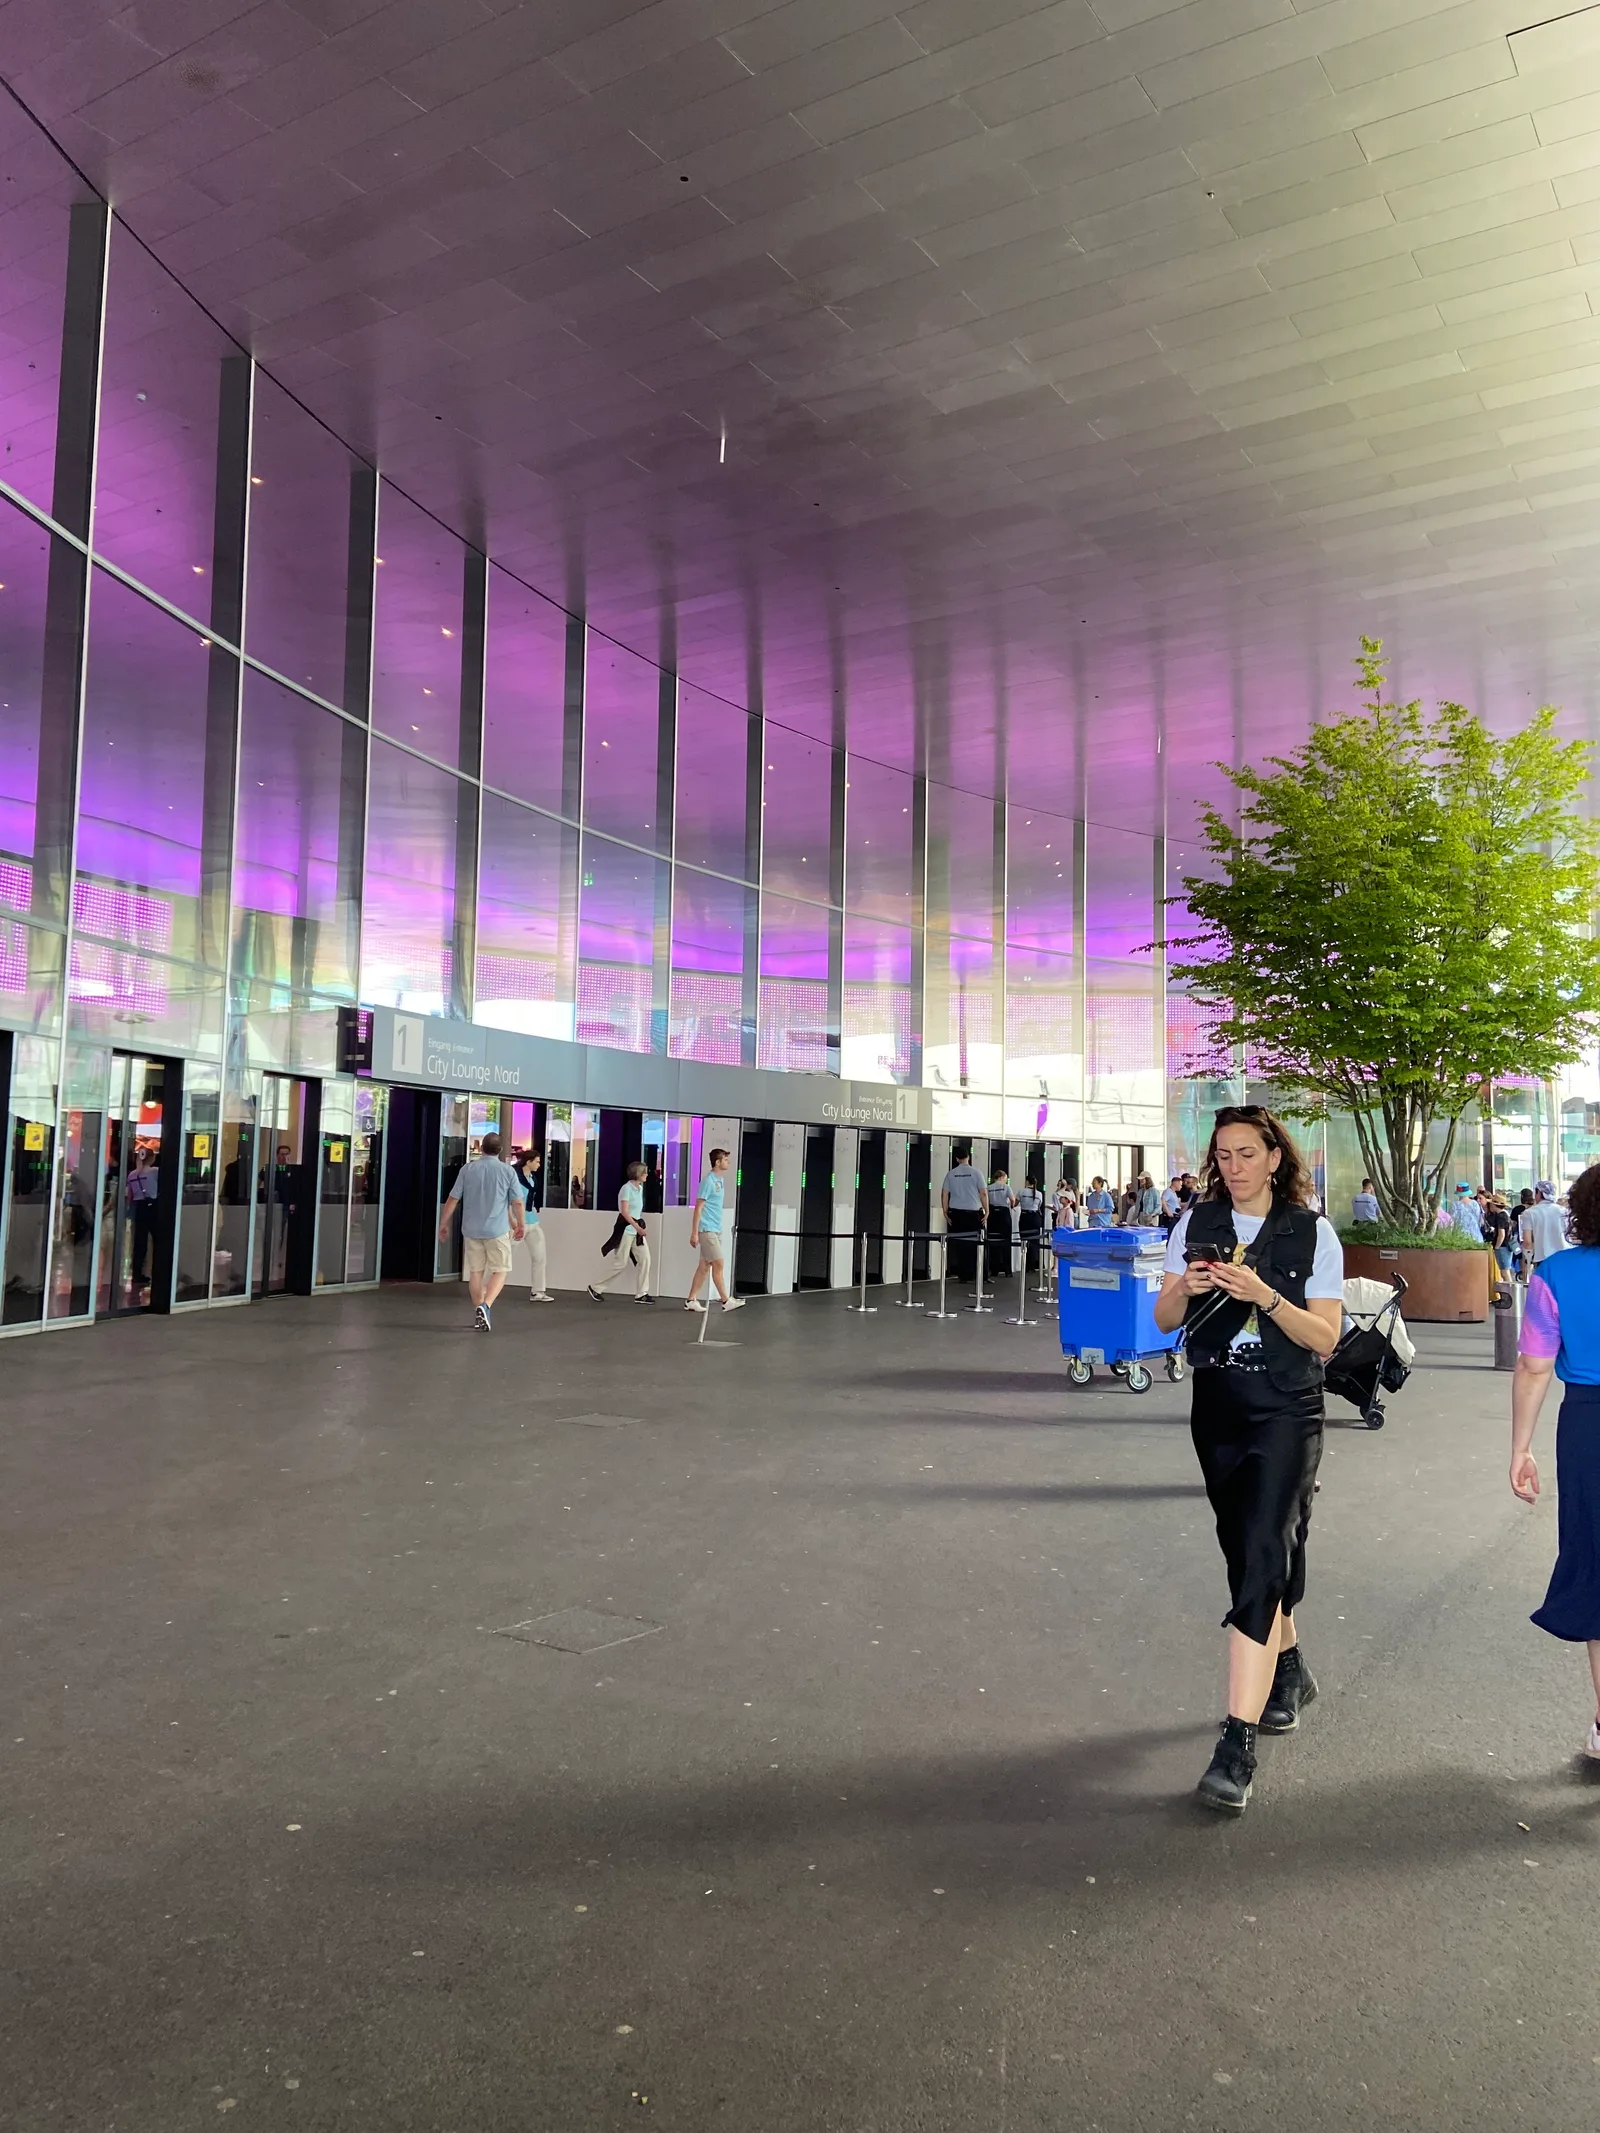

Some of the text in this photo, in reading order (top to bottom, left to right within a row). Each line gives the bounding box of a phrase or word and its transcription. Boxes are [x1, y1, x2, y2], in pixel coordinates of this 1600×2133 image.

[397, 1024, 407, 1065] 1
[428, 1037, 451, 1053] Eingang
[427, 1055, 519, 1085] City Lounge Nord
[822, 1103, 893, 1122] City Lounge Nord
[899, 1094, 906, 1119] 1
